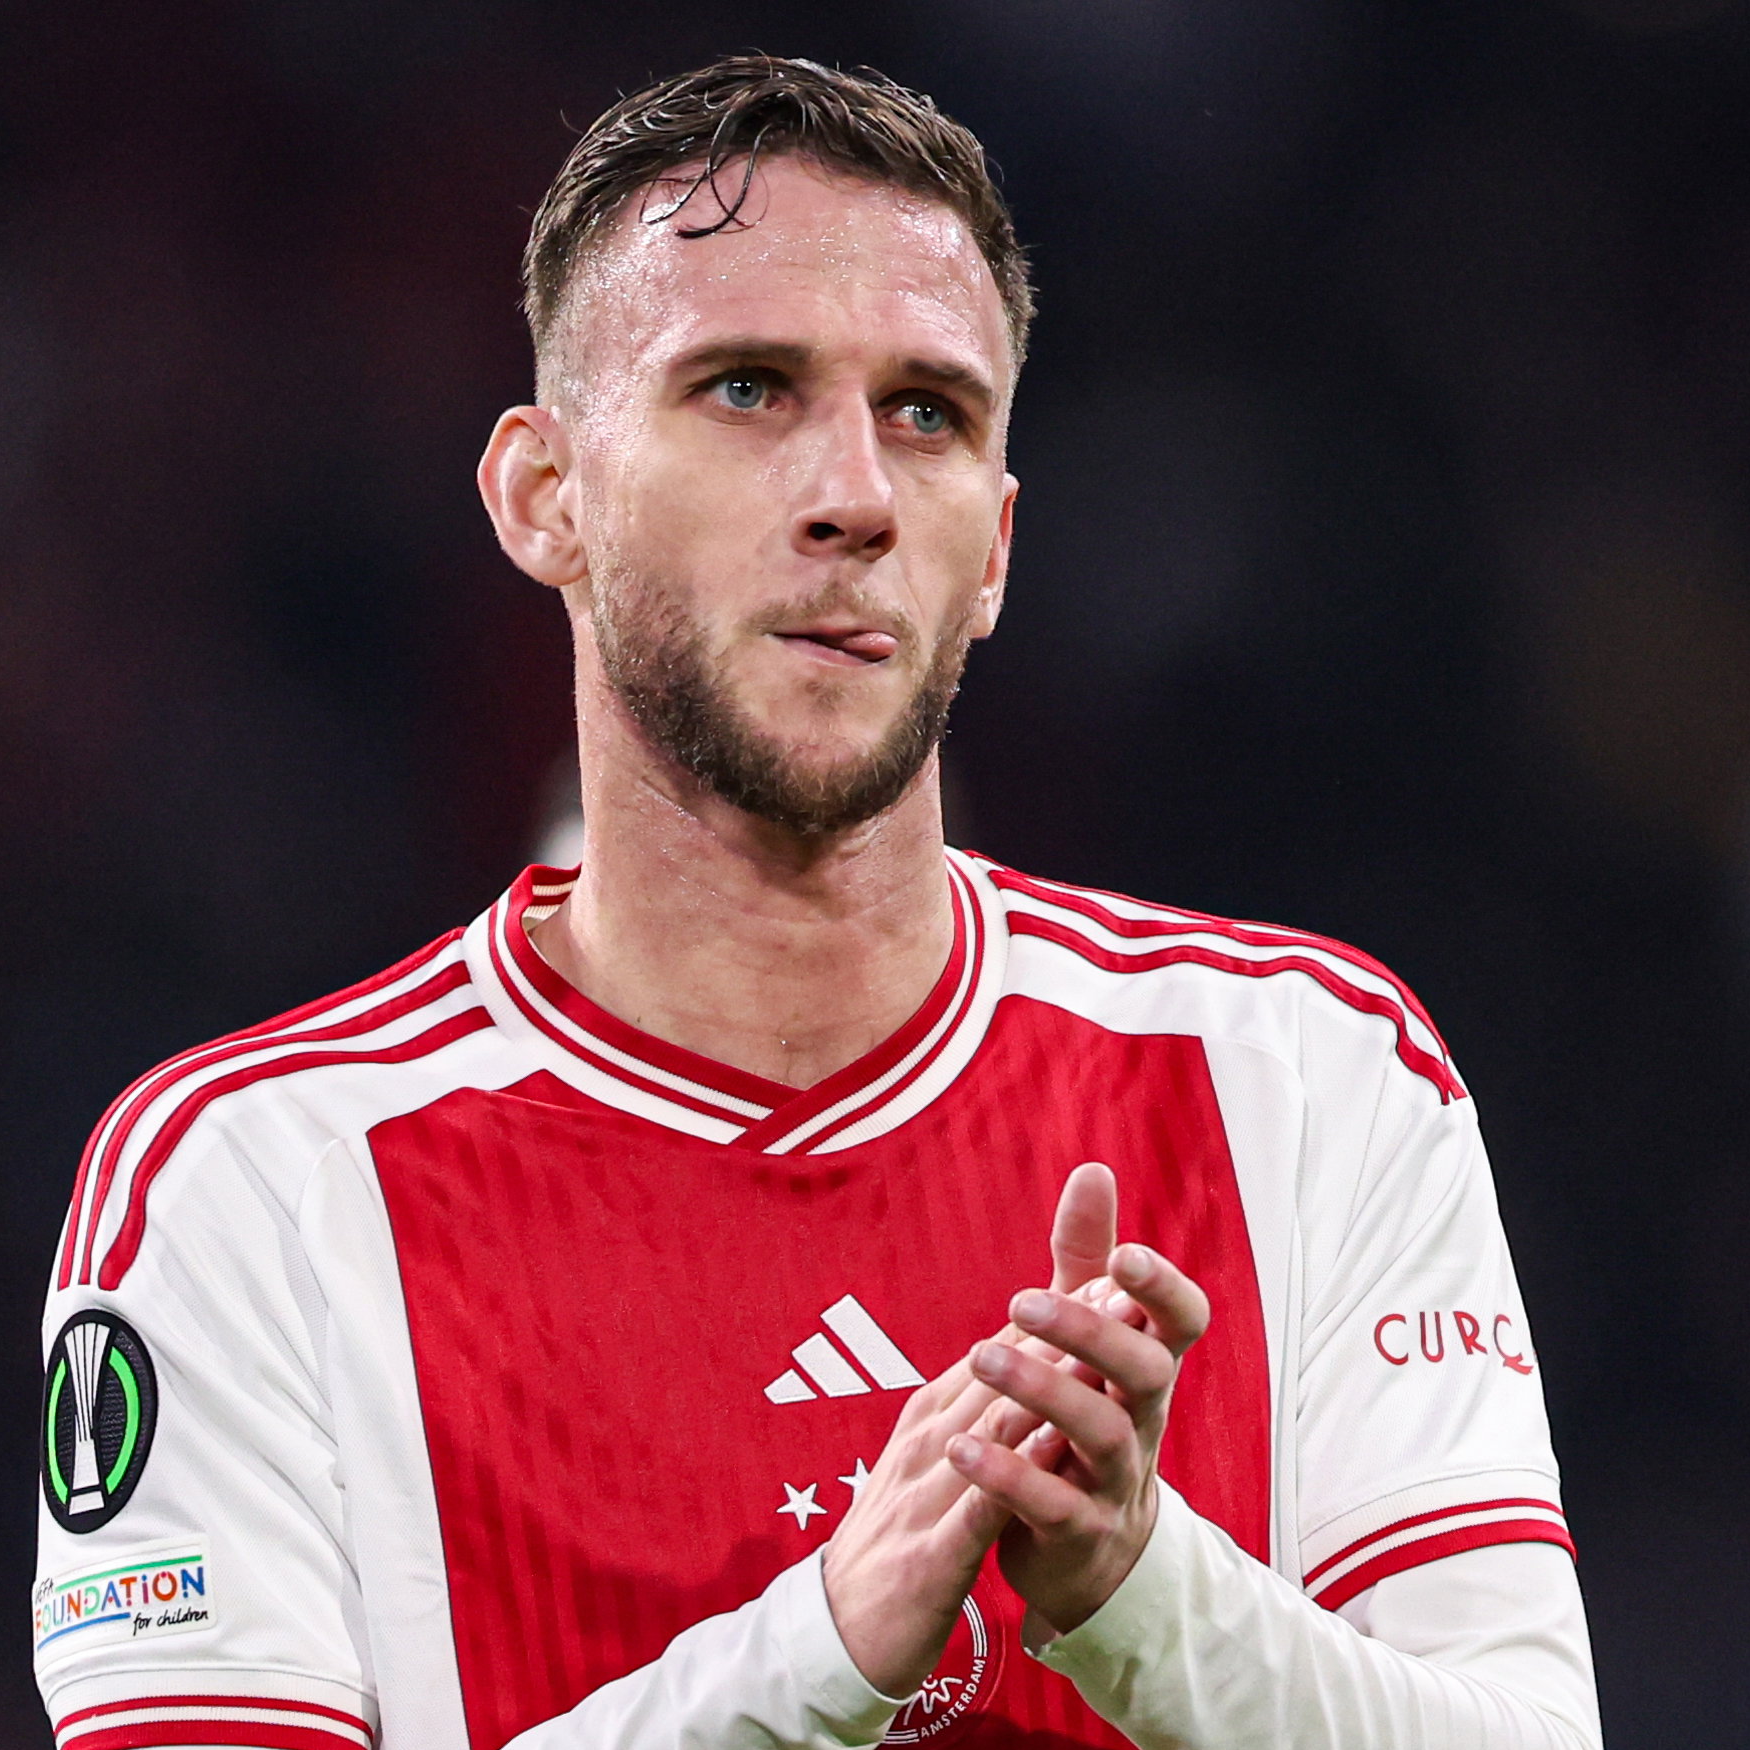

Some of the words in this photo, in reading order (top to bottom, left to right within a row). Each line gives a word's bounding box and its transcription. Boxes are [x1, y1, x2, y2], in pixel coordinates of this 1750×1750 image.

[35, 1566, 205, 1639] FOUNDATION
[133, 1611, 152, 1637] for
[156, 1606, 209, 1627] children
[919, 1658, 987, 1739] AMSTERDAM
